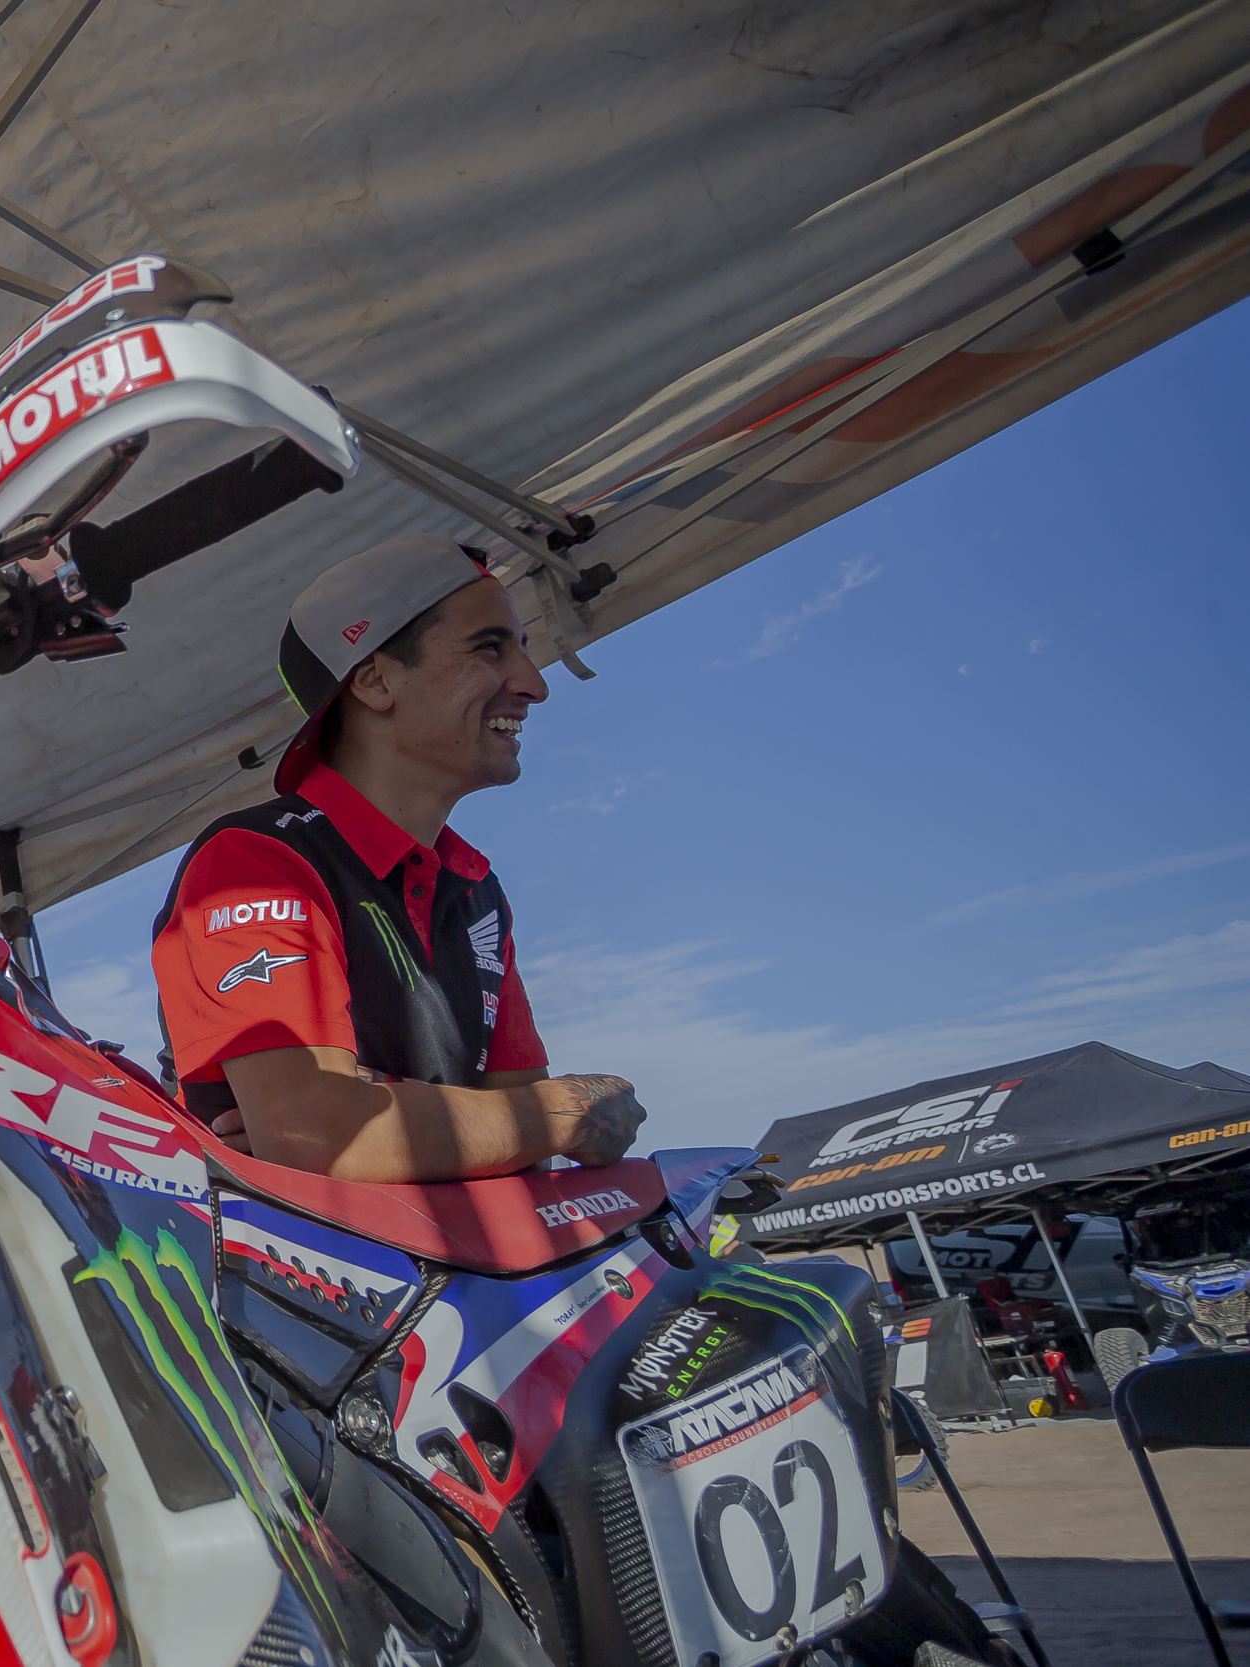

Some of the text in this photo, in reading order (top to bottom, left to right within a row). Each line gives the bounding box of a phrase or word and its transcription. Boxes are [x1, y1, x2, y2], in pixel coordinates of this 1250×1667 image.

[208, 900, 307, 933] MOTUL
[808, 1115, 996, 1169] MOTOR SPORTS
[50, 1146, 210, 1199] 450 RALLY
[752, 1163, 1046, 1233] WWW.CSIMOTORSPORTS.CL
[536, 1189, 639, 1227] HONDA
[667, 1326, 727, 1398] ENERGY
[694, 1438, 868, 1642] 02
